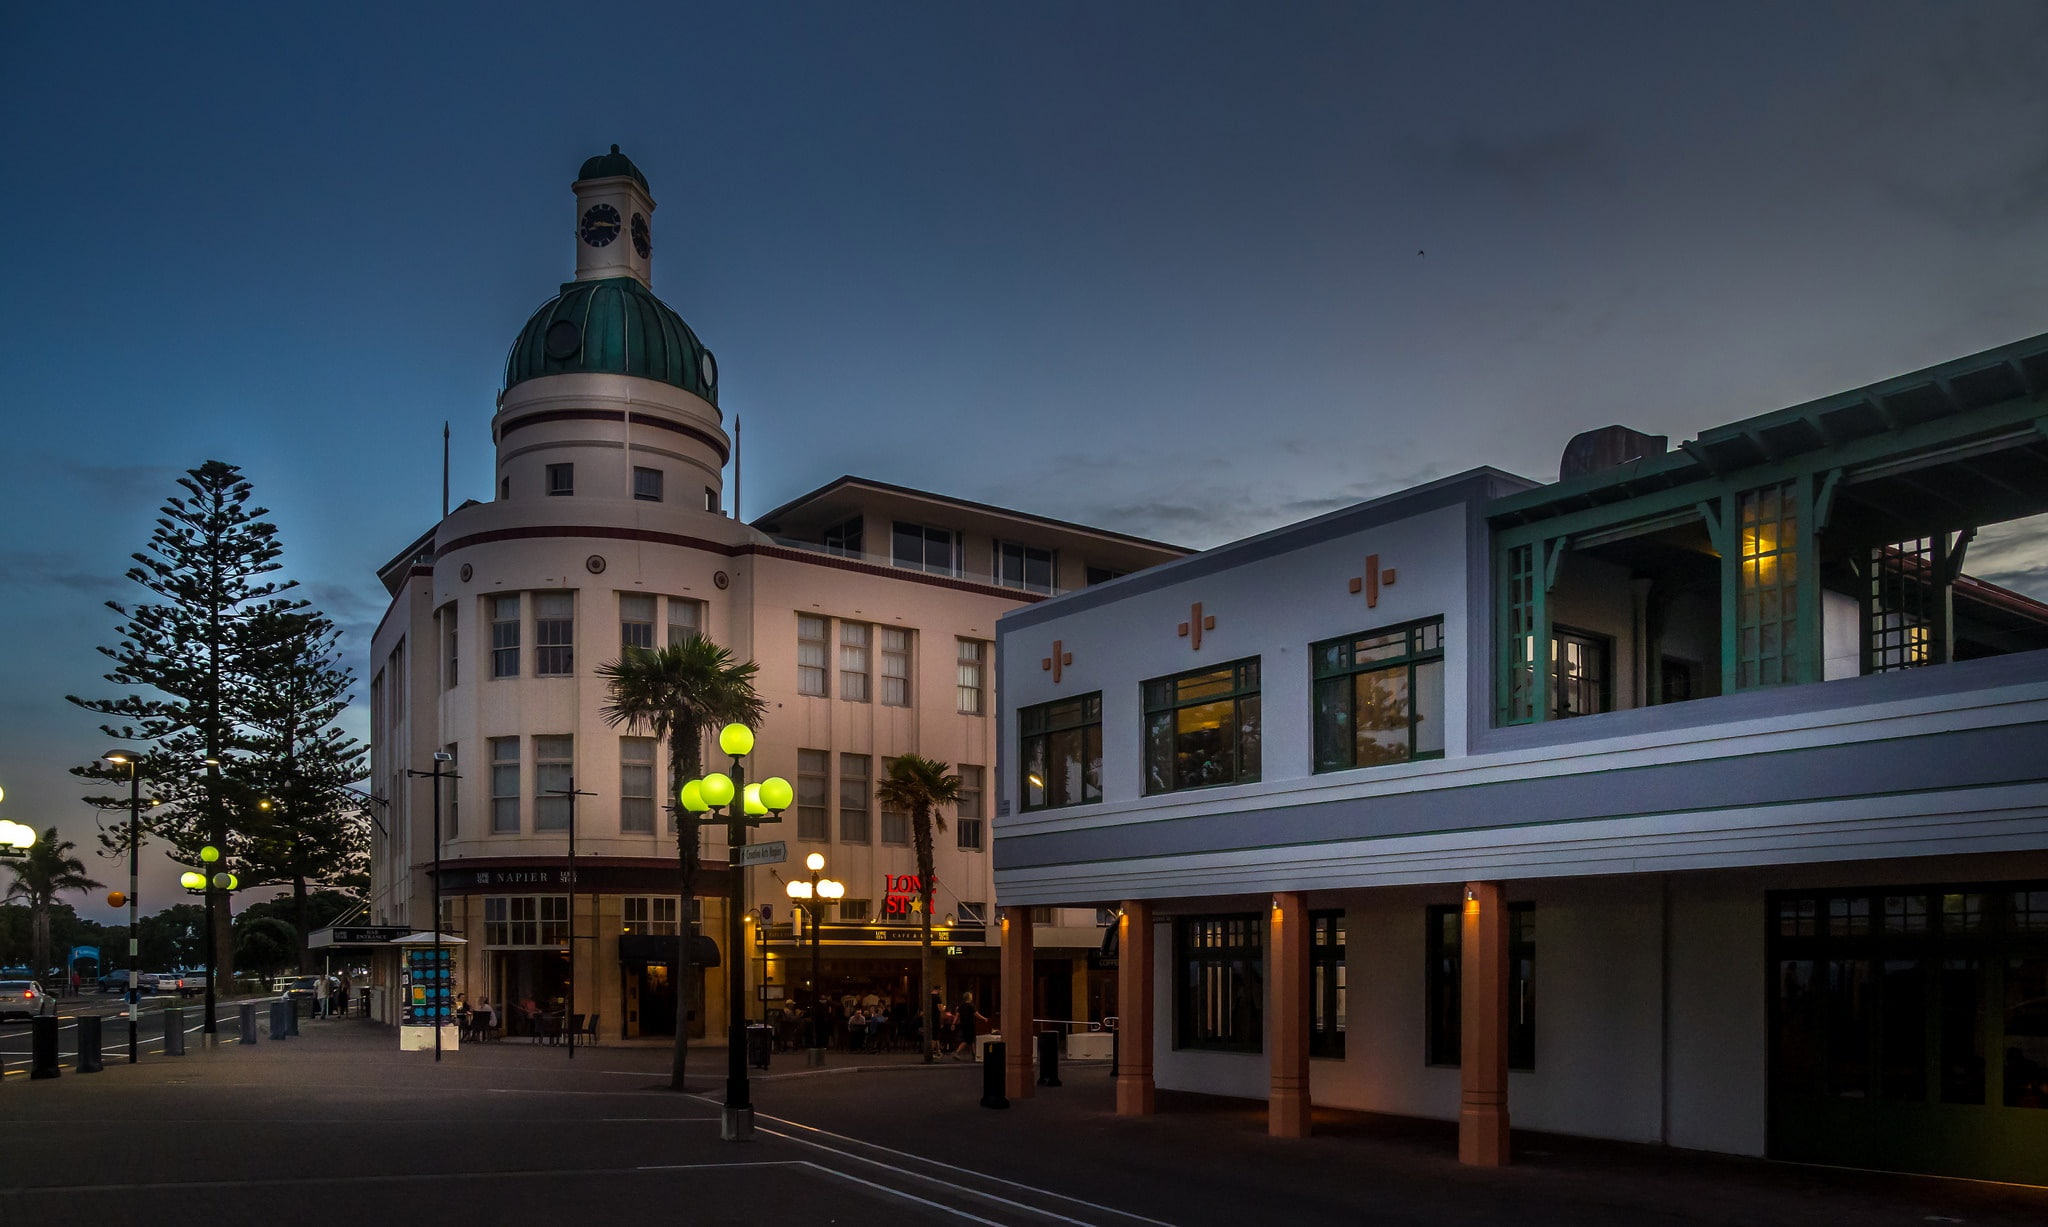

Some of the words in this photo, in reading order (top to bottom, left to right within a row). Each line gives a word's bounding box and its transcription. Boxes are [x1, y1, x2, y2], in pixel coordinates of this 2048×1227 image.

[497, 872, 548, 882] NAPIER
[885, 874, 938, 893] LON
[1098, 959, 1119, 967] COFFE
